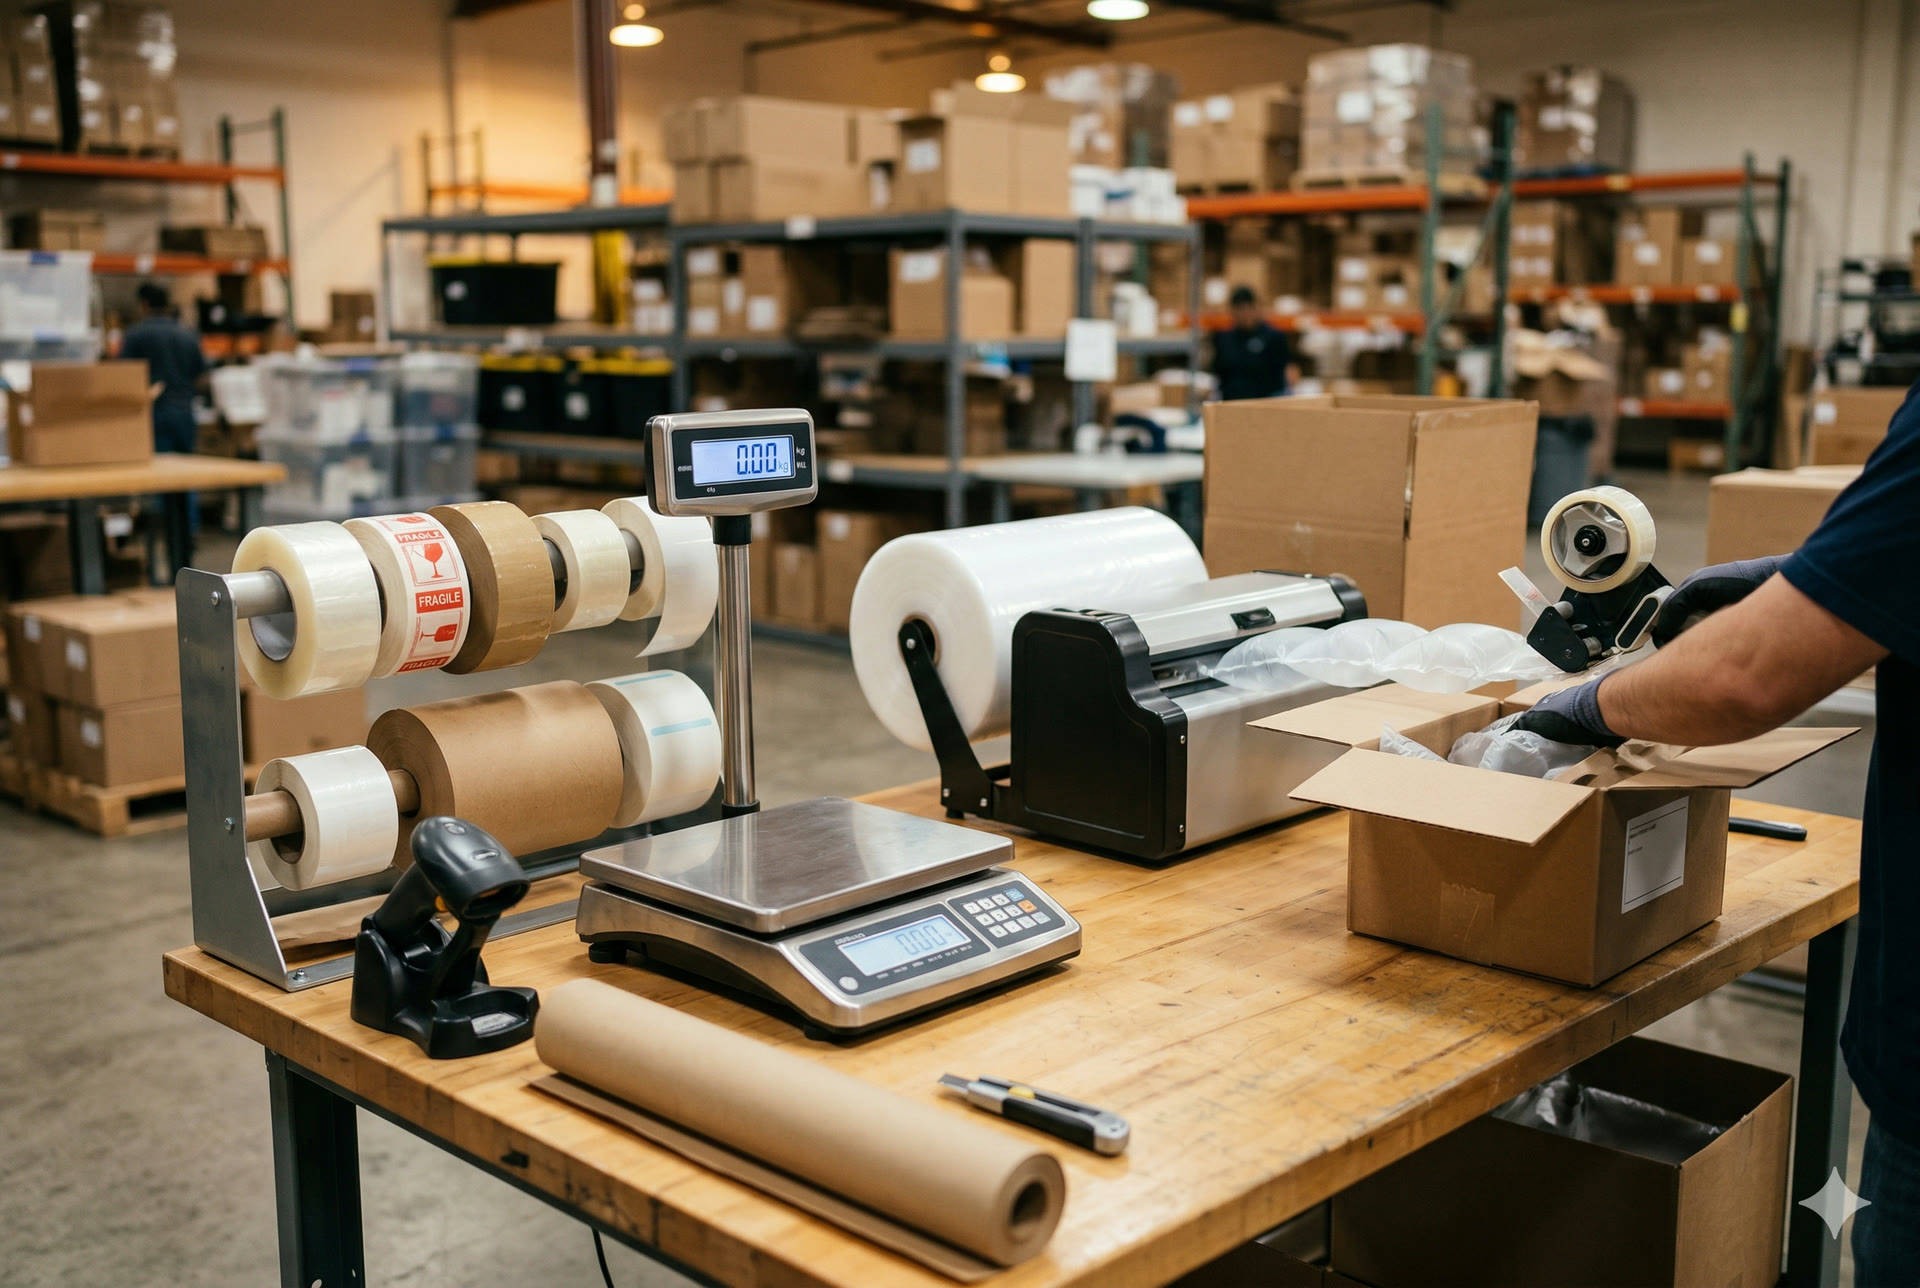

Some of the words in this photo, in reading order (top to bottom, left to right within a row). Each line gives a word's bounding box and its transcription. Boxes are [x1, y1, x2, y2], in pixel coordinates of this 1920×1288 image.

[736, 442, 777, 475] 0.00
[778, 461, 789, 473] kg
[418, 591, 461, 608] FRAGILE
